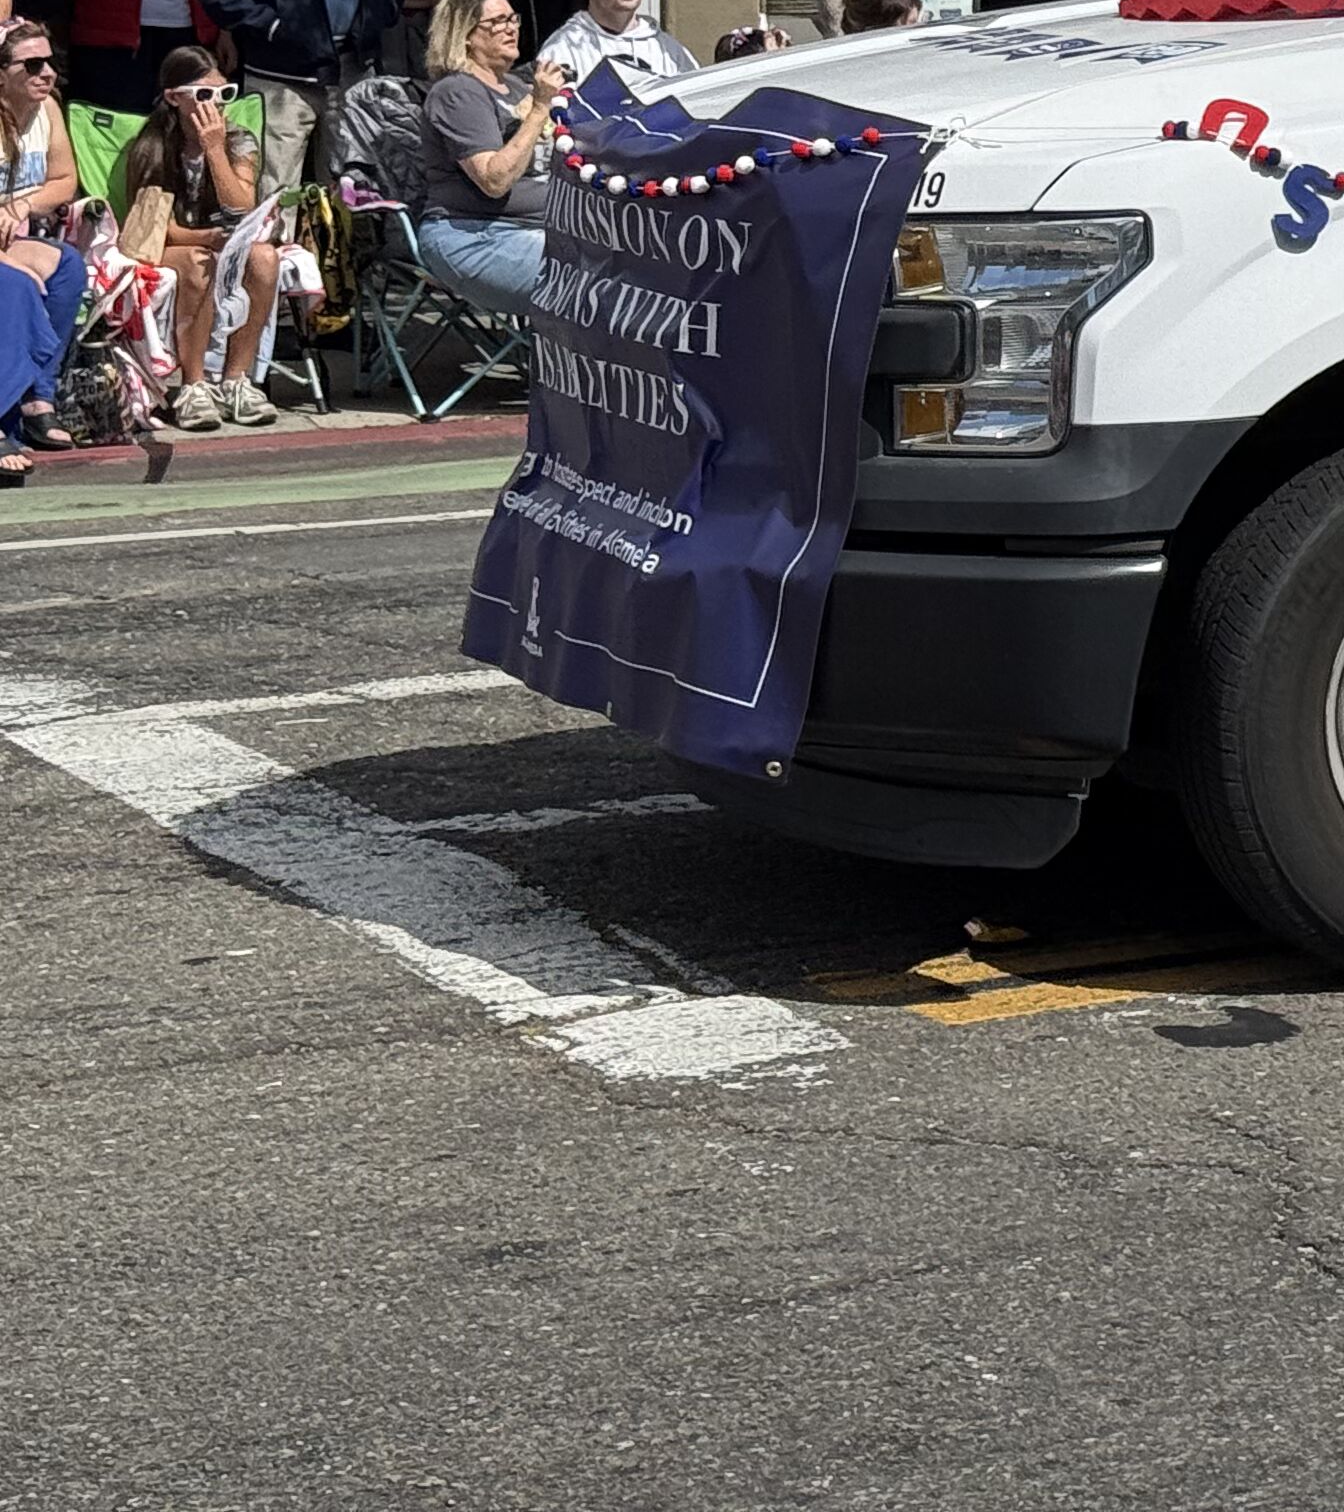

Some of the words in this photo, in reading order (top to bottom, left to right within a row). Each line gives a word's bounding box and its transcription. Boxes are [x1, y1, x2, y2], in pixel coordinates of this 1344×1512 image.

[678, 214, 751, 275] ON
[608, 282, 722, 358] WITH
[612, 486, 643, 515] and
